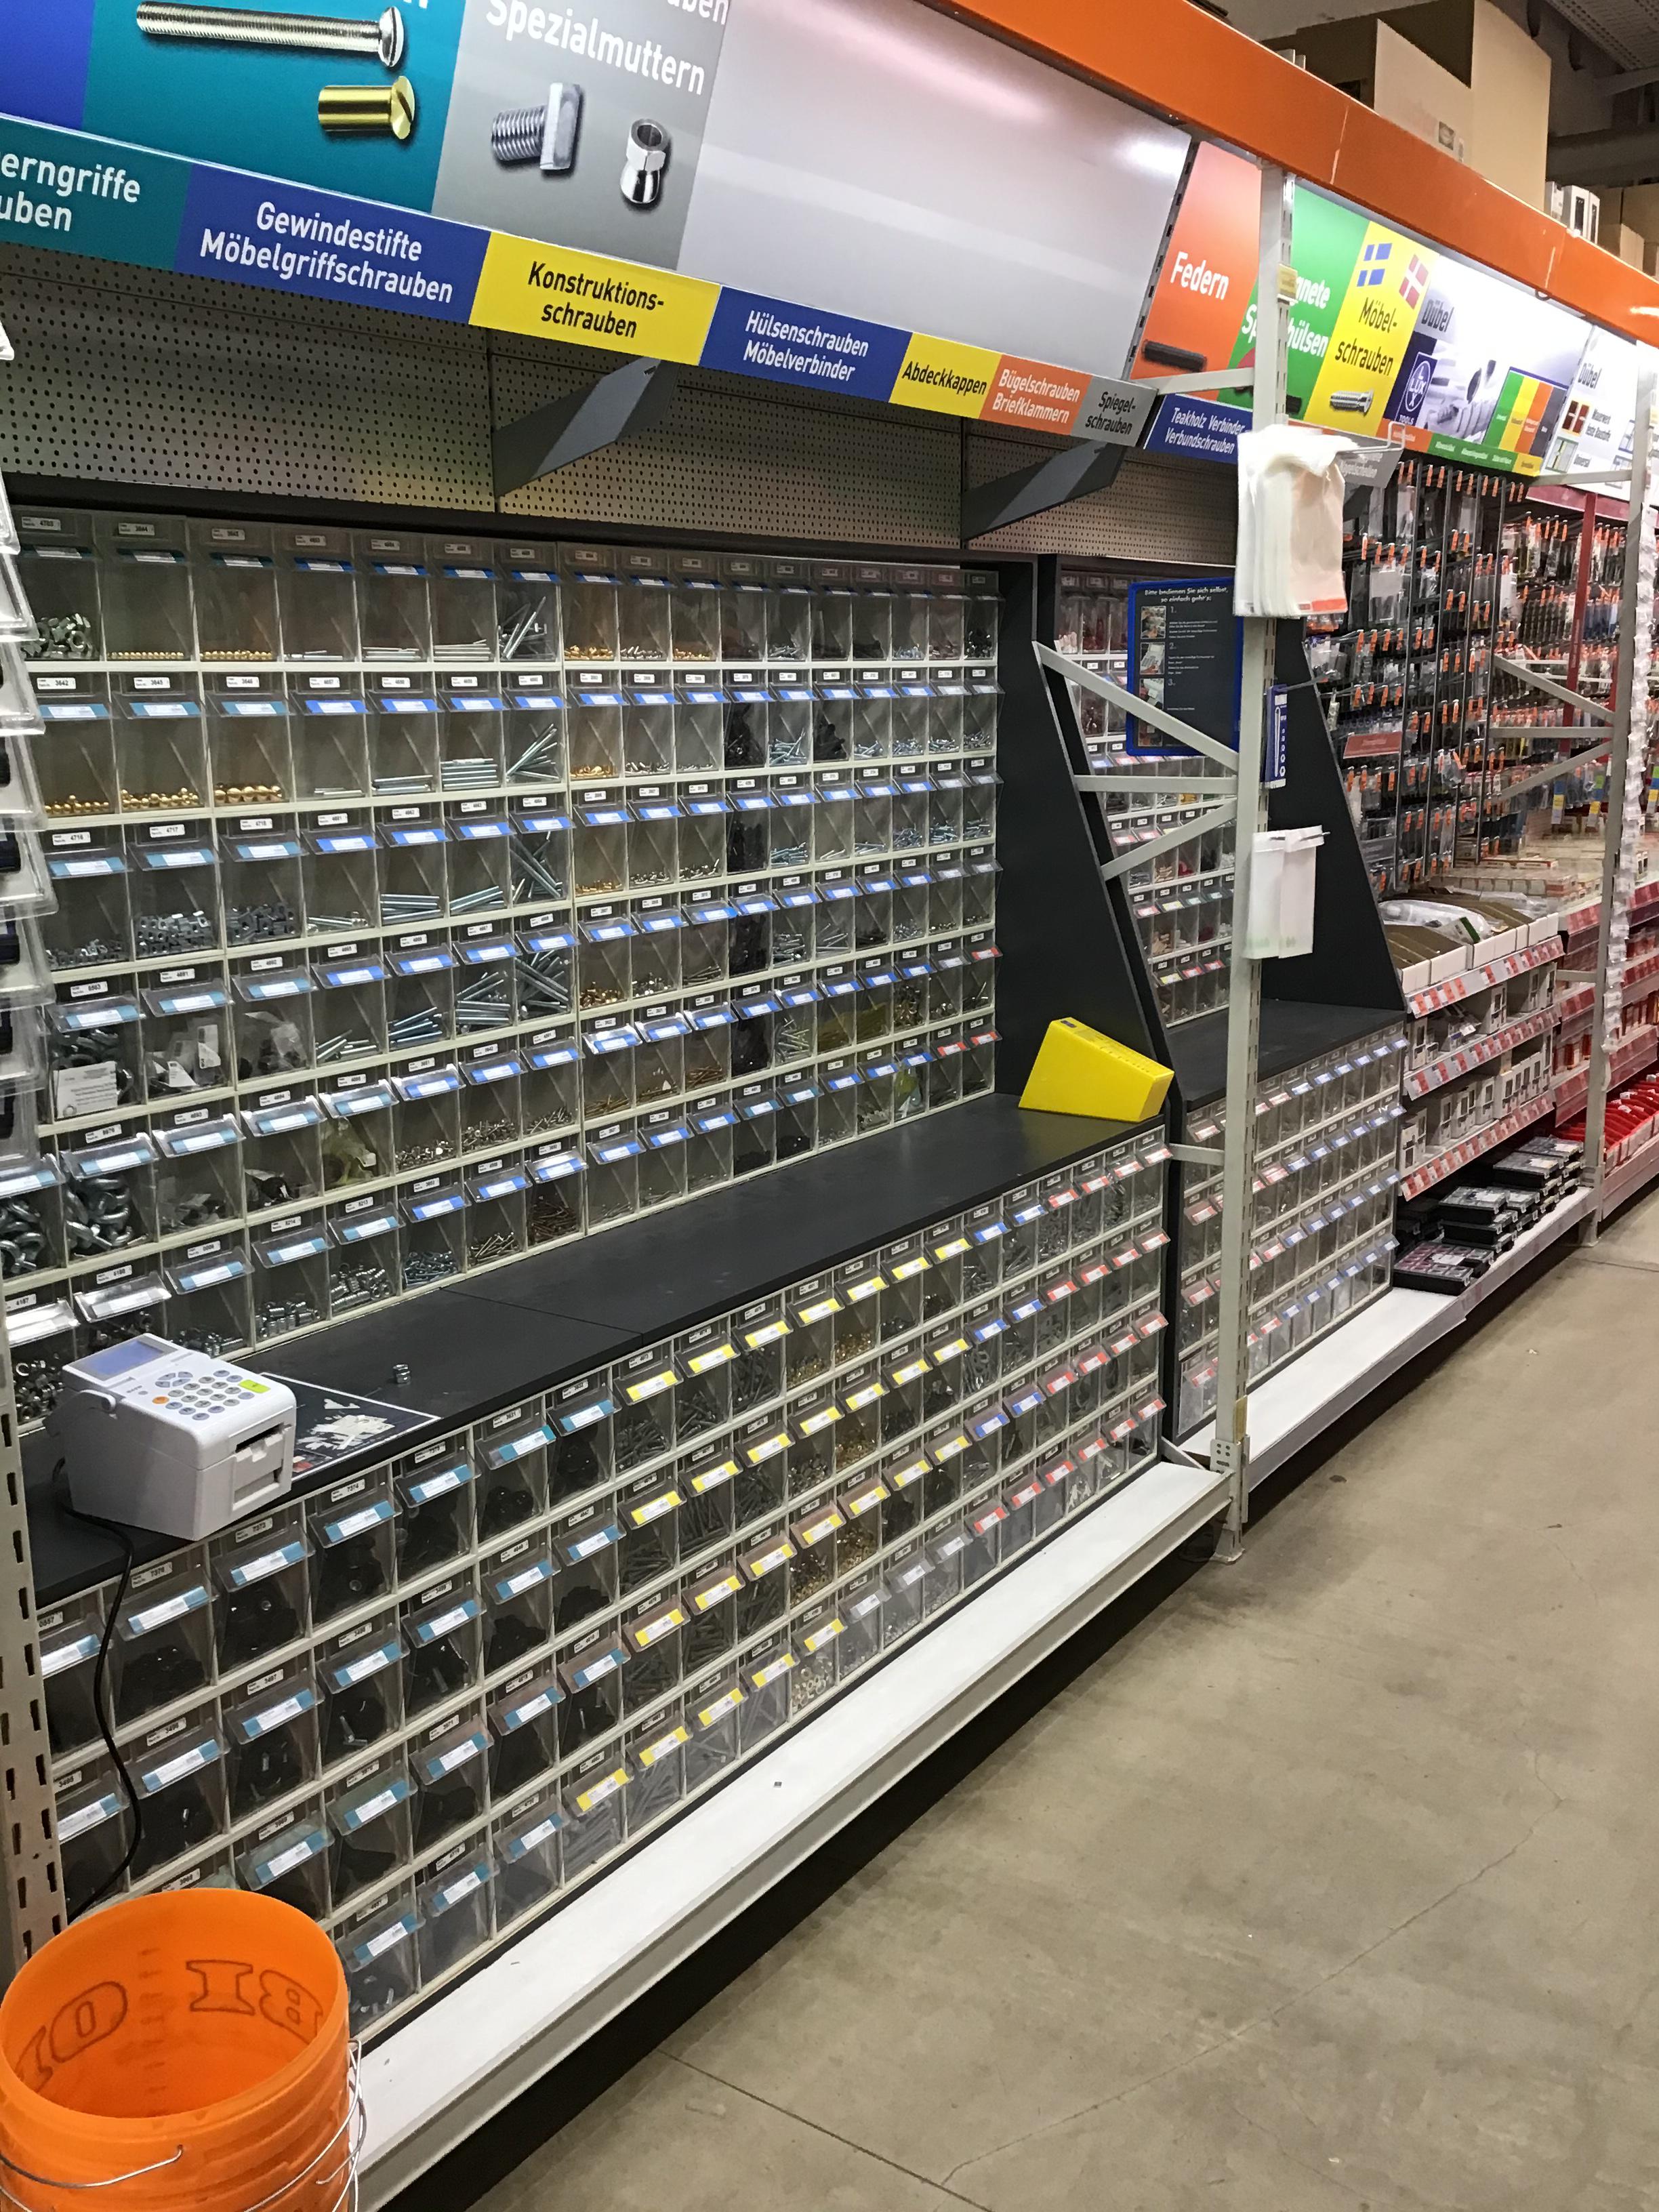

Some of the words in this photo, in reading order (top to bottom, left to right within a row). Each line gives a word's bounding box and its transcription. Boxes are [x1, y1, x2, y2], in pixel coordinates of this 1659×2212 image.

[486, 0, 705, 96] Spezialmuttern
[0, 152, 141, 203] erngriffe
[256, 201, 423, 262] Gewindestifte
[199, 228, 453, 304] Möbelgriffschrauben
[1170, 251, 1230, 301] Federn
[527, 260, 665, 311] Konstruktions-
[540, 302, 637, 339] schrauben
[745, 309, 869, 358] Hülsenschrauben
[1357, 297, 1398, 334] Möbel-
[1420, 298, 1455, 333] Dübel
[743, 339, 856, 382] Möbelverbinder
[1334, 337, 1394, 377] schrauben
[901, 361, 988, 396] Abdeckkappen
[998, 367, 1081, 403] Bügelschrauben
[1577, 362, 1603, 390] Dübel
[991, 391, 1071, 425] Briefklammern
[1098, 391, 1136, 415] Spiegel-
[1170, 407, 1208, 429] Teakholz
[1208, 414, 1247, 436] Verbinder
[1085, 413, 1133, 435] schrauben
[1164, 427, 1236, 455] Verbundschrauben
